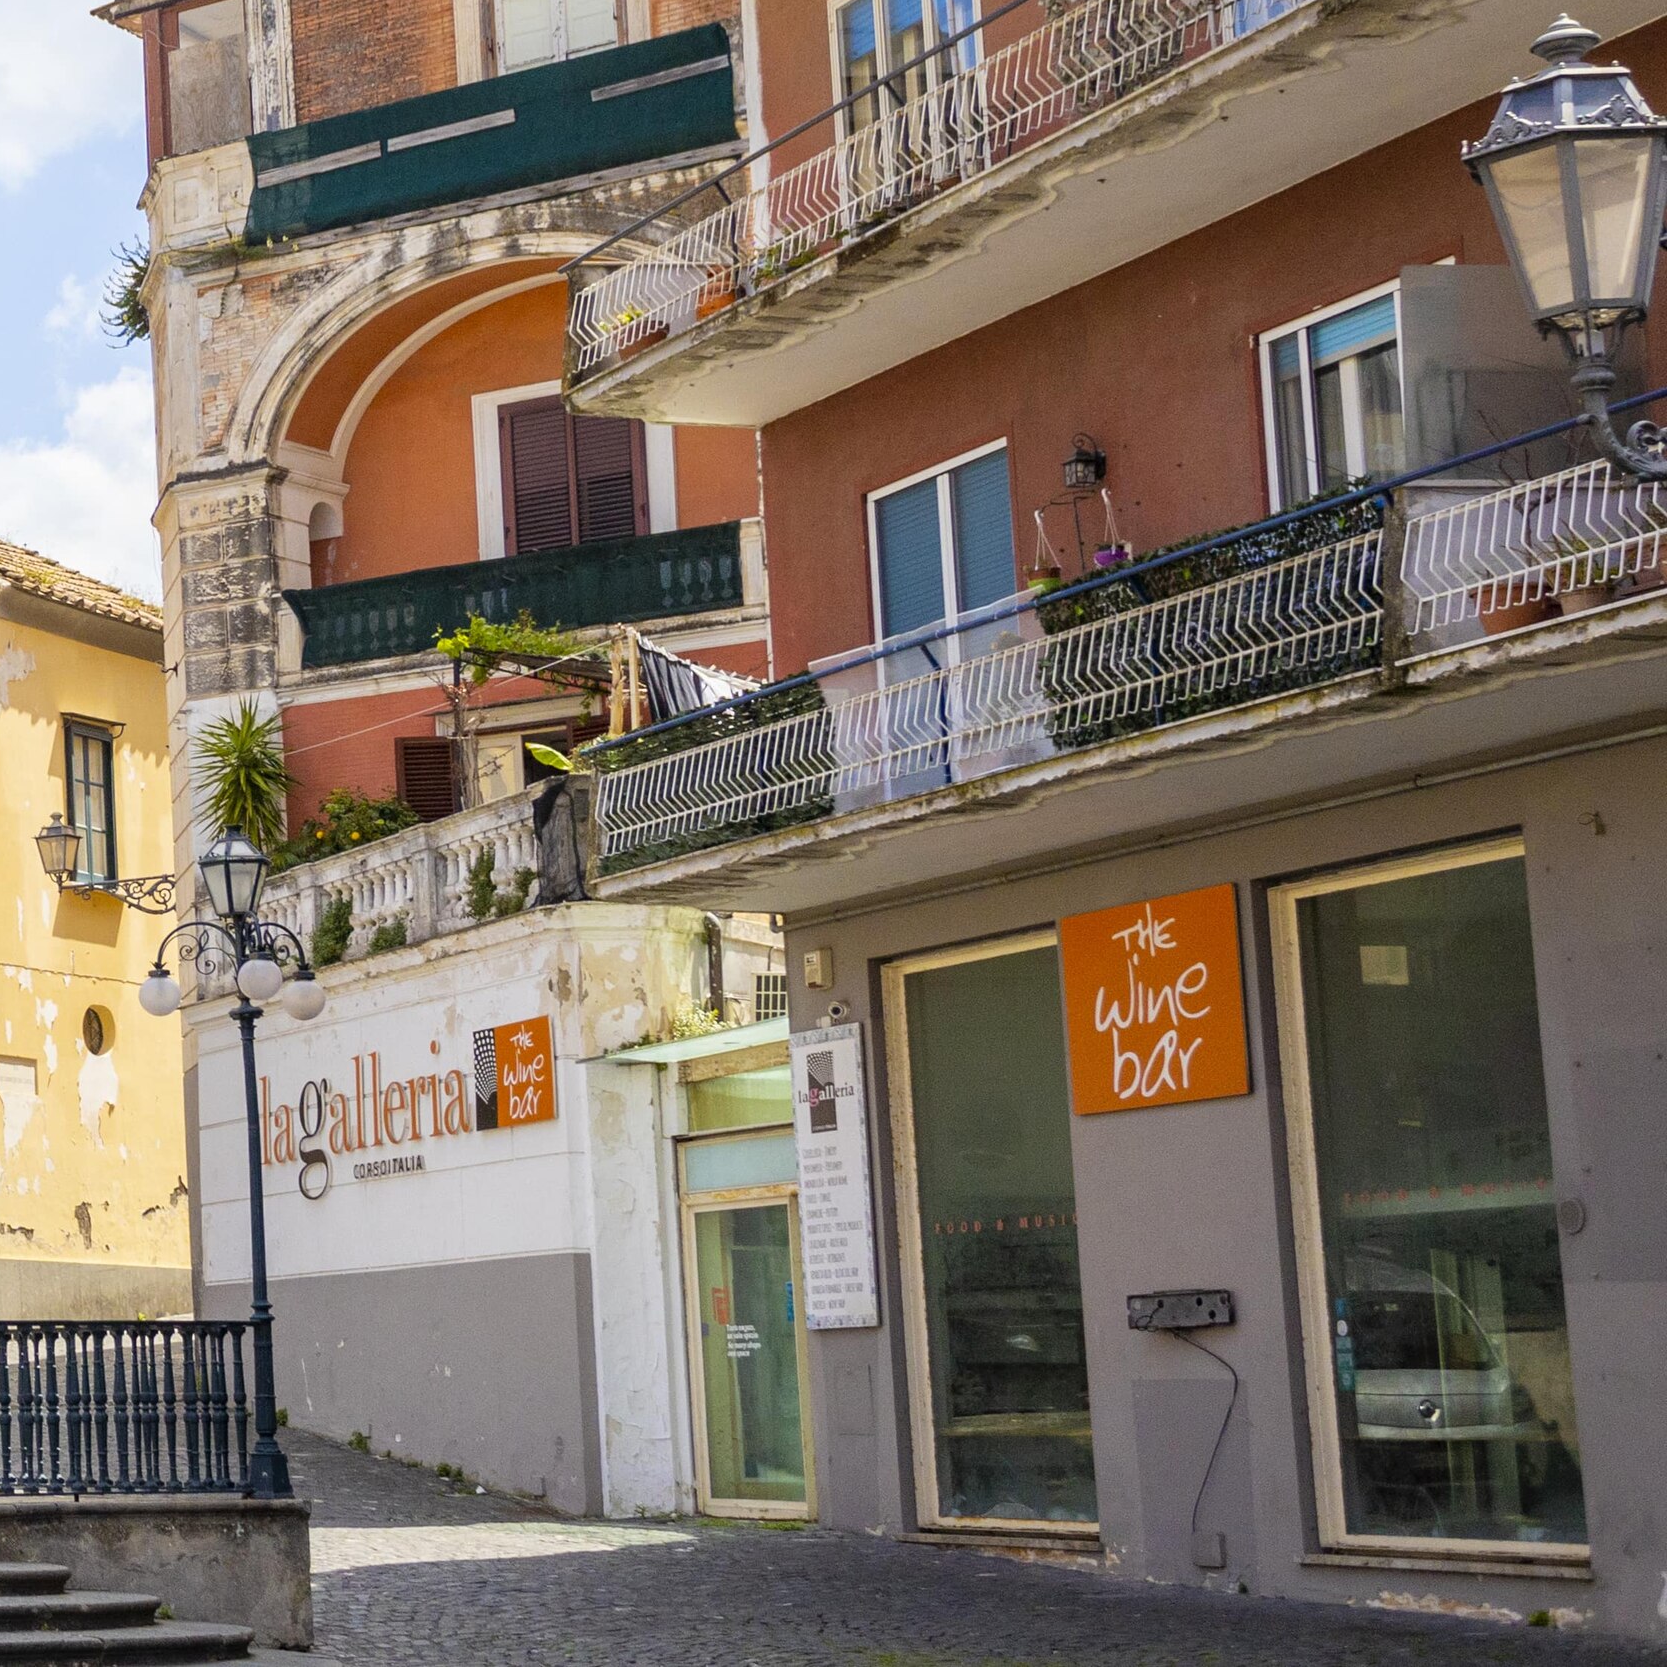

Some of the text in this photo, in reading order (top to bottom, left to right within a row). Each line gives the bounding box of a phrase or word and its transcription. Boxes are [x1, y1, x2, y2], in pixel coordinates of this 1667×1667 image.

[1111, 902, 1177, 957] THE
[509, 1023, 535, 1051] THE
[1112, 1026, 1203, 1100] bar
[509, 1084, 542, 1119] bar
